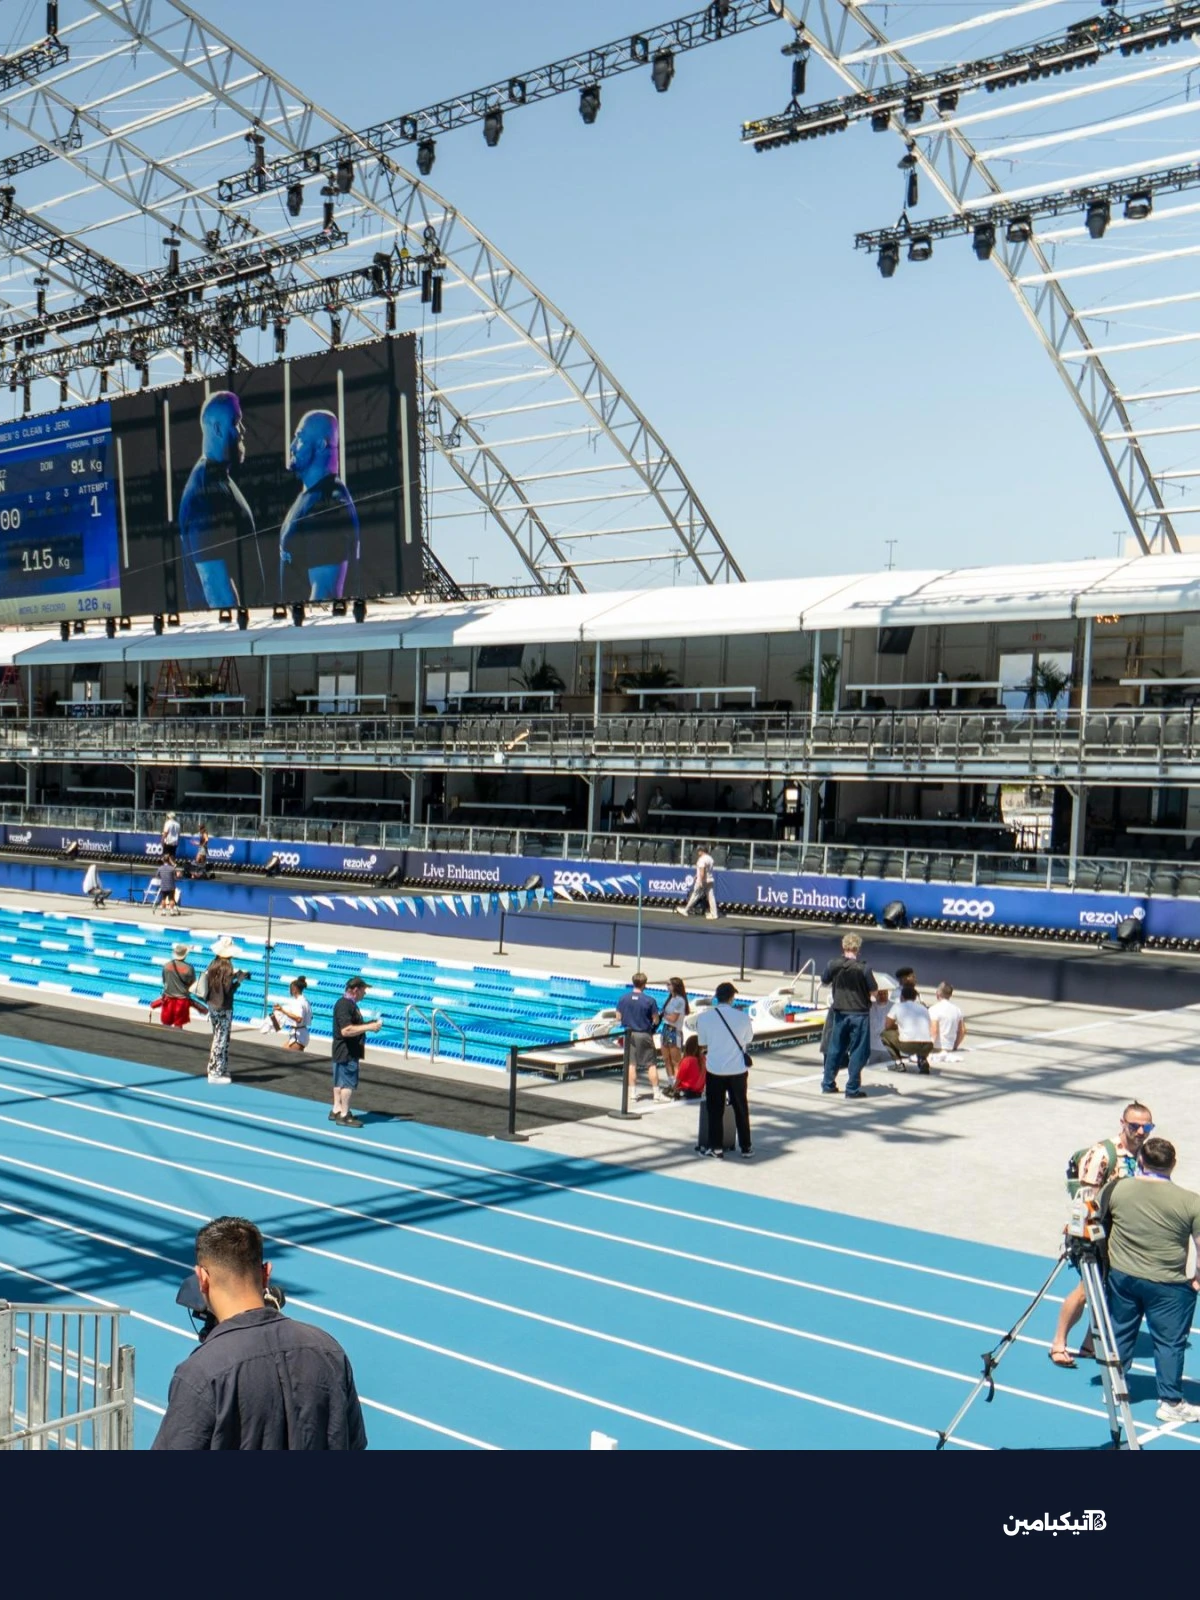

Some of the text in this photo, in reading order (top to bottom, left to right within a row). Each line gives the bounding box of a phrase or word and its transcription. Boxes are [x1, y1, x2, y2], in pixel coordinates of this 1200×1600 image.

[22, 425, 43, 438] CLEAN
[45, 424, 51, 433] &
[54, 419, 71, 431] JERK
[66, 439, 91, 449] PERSONAL
[70, 459, 103, 474] 91 Kg
[28, 488, 69, 503] 1 2 3
[78, 481, 109, 495] ATTEMPT
[90, 496, 102, 517] 1
[22, 548, 70, 572] 115 Kg
[18, 598, 111, 615] WORLD RECORD 126 Kg
[145, 843, 163, 855] zoo
[343, 857, 373, 868] rezolve
[423, 862, 500, 882] Live Enhanced
[649, 878, 689, 891] rezolve
[757, 886, 866, 910] Live Enhanced
[942, 898, 995, 920] zoop
[1080, 910, 1135, 925] rezolv
